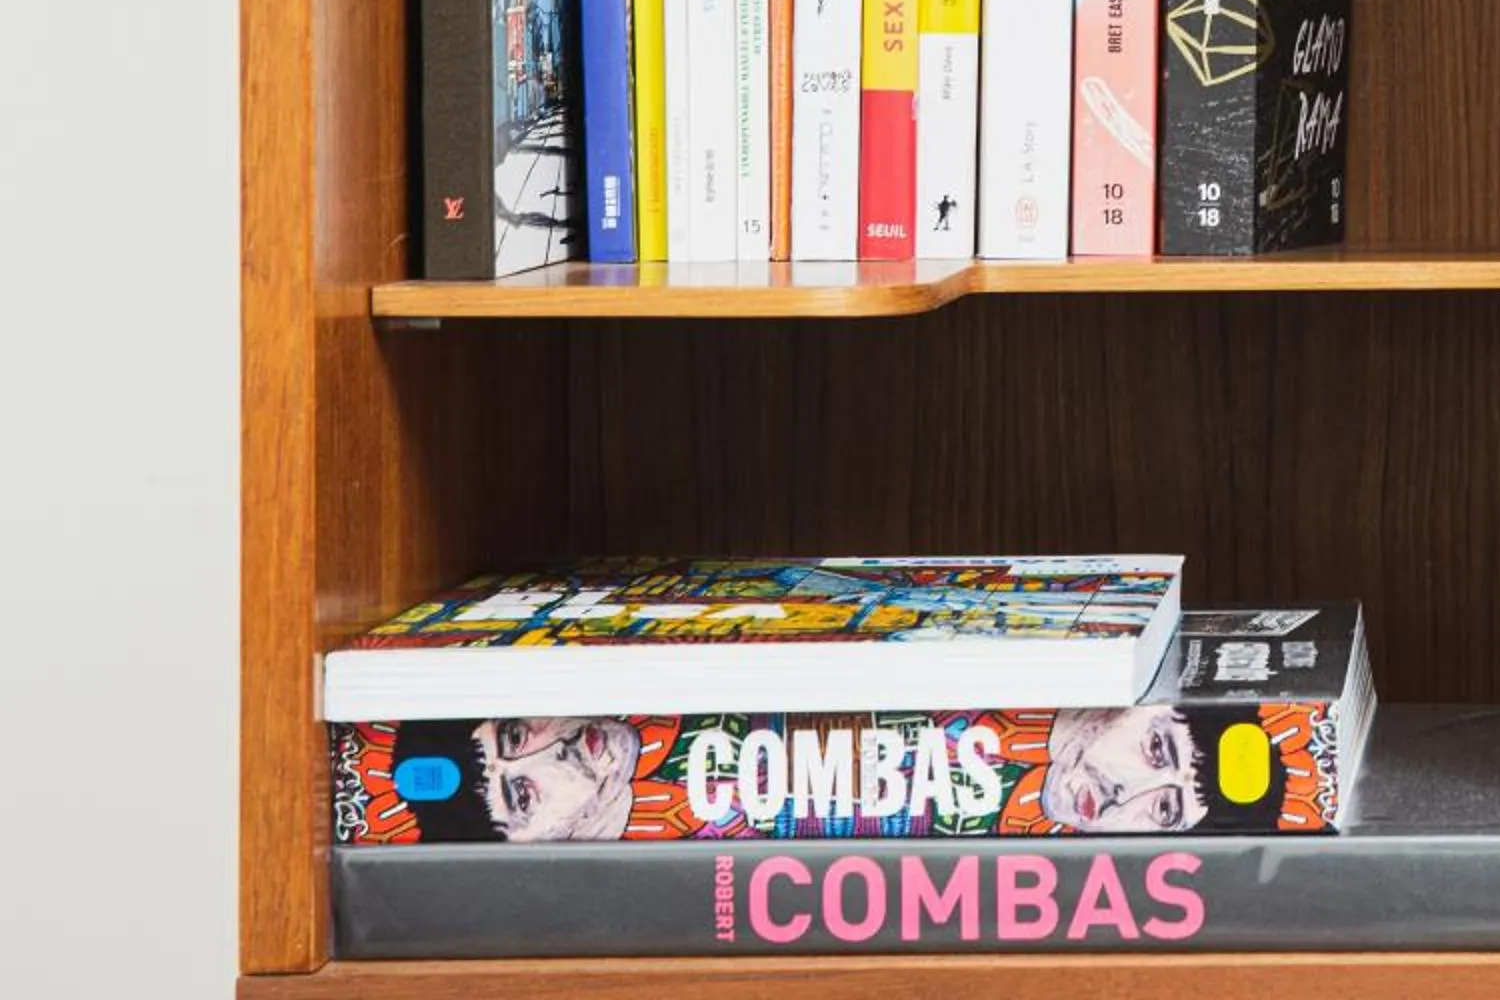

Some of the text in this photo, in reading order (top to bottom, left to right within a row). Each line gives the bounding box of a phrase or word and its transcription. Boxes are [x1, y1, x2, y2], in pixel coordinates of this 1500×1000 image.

[884, 1, 904, 52] SEX
[1107, 24, 1123, 53] BRET
[1294, 90, 1344, 161] RAMA
[1102, 183, 1124, 200] 10
[1197, 182, 1221, 201] 10
[743, 219, 762, 233] 15
[1103, 208, 1123, 225] 18
[1197, 208, 1221, 227] 18
[867, 223, 907, 239] SEUIL
[686, 724, 1002, 822] COMBAS
[714, 855, 735, 943] ROBERT
[749, 851, 1206, 944] COMBAS
